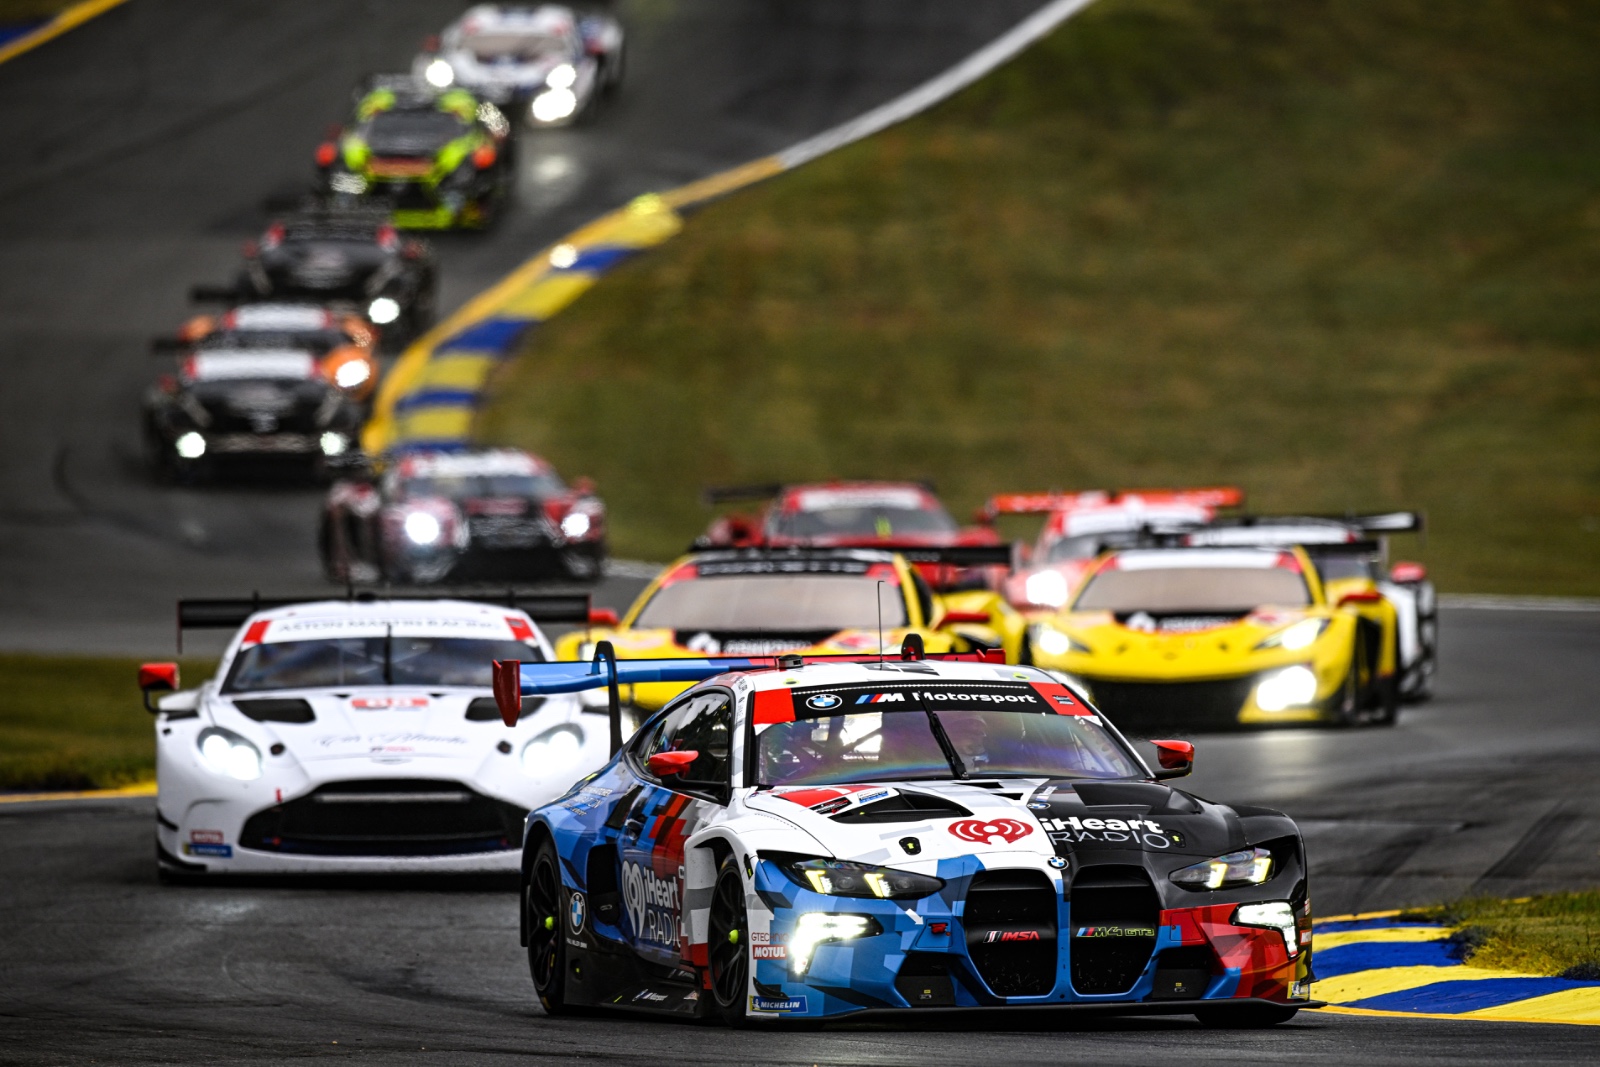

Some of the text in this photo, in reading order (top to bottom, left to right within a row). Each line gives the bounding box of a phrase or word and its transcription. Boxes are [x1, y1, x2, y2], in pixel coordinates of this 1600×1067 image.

[913, 692, 1037, 704] Motorsport
[1038, 816, 1164, 834] iHeart
[1047, 829, 1171, 849] RADIO
[643, 866, 681, 911] iHeart
[1001, 930, 1040, 941] IMSA
[1093, 926, 1155, 937] M4 GT3
[754, 946, 786, 958] MOTUL
[760, 1001, 801, 1009] MICHELIN
